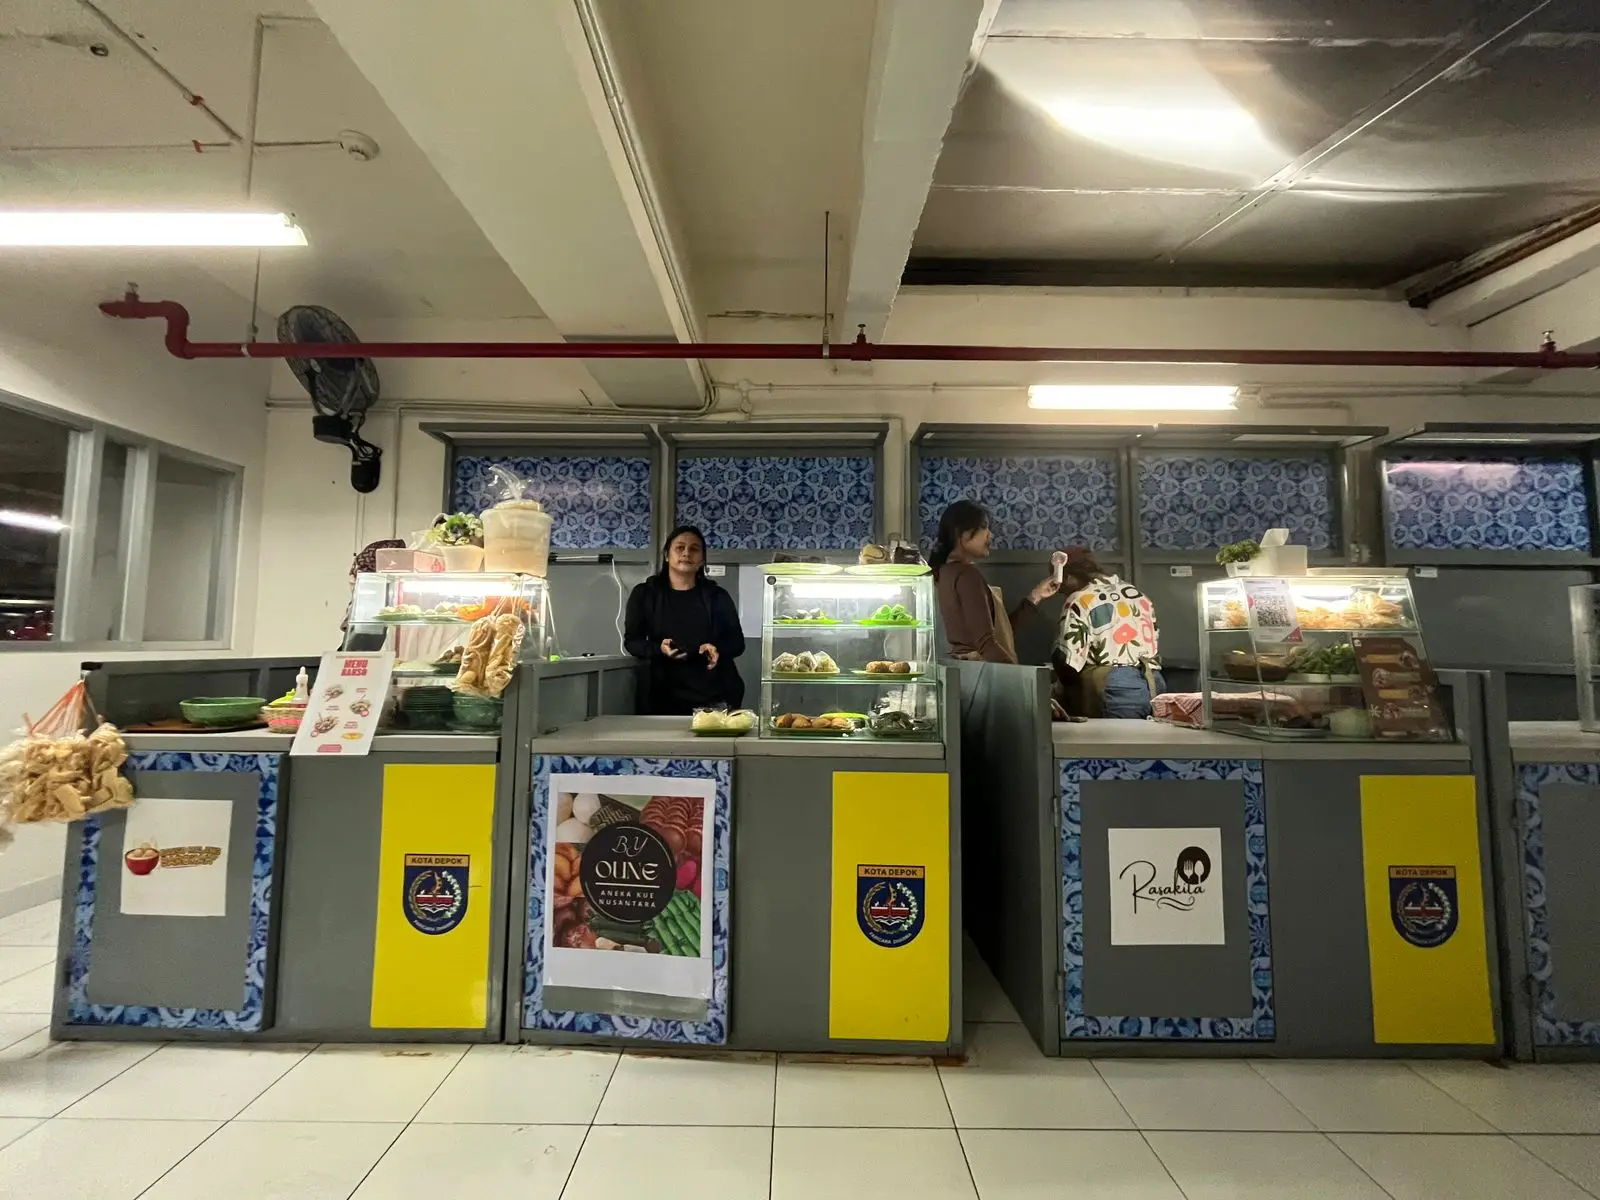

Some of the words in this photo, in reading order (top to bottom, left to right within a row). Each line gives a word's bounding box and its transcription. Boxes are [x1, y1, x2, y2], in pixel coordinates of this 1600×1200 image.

[611, 835, 649, 858] BY
[411, 857, 433, 865] KOTA
[434, 857, 462, 865] DEPOK
[864, 867, 887, 876] KOTA
[888, 868, 918, 877] DEPOK
[600, 889, 632, 898] ANEKA
[636, 891, 655, 899] KUE
[598, 899, 656, 908] NUSANTARA
